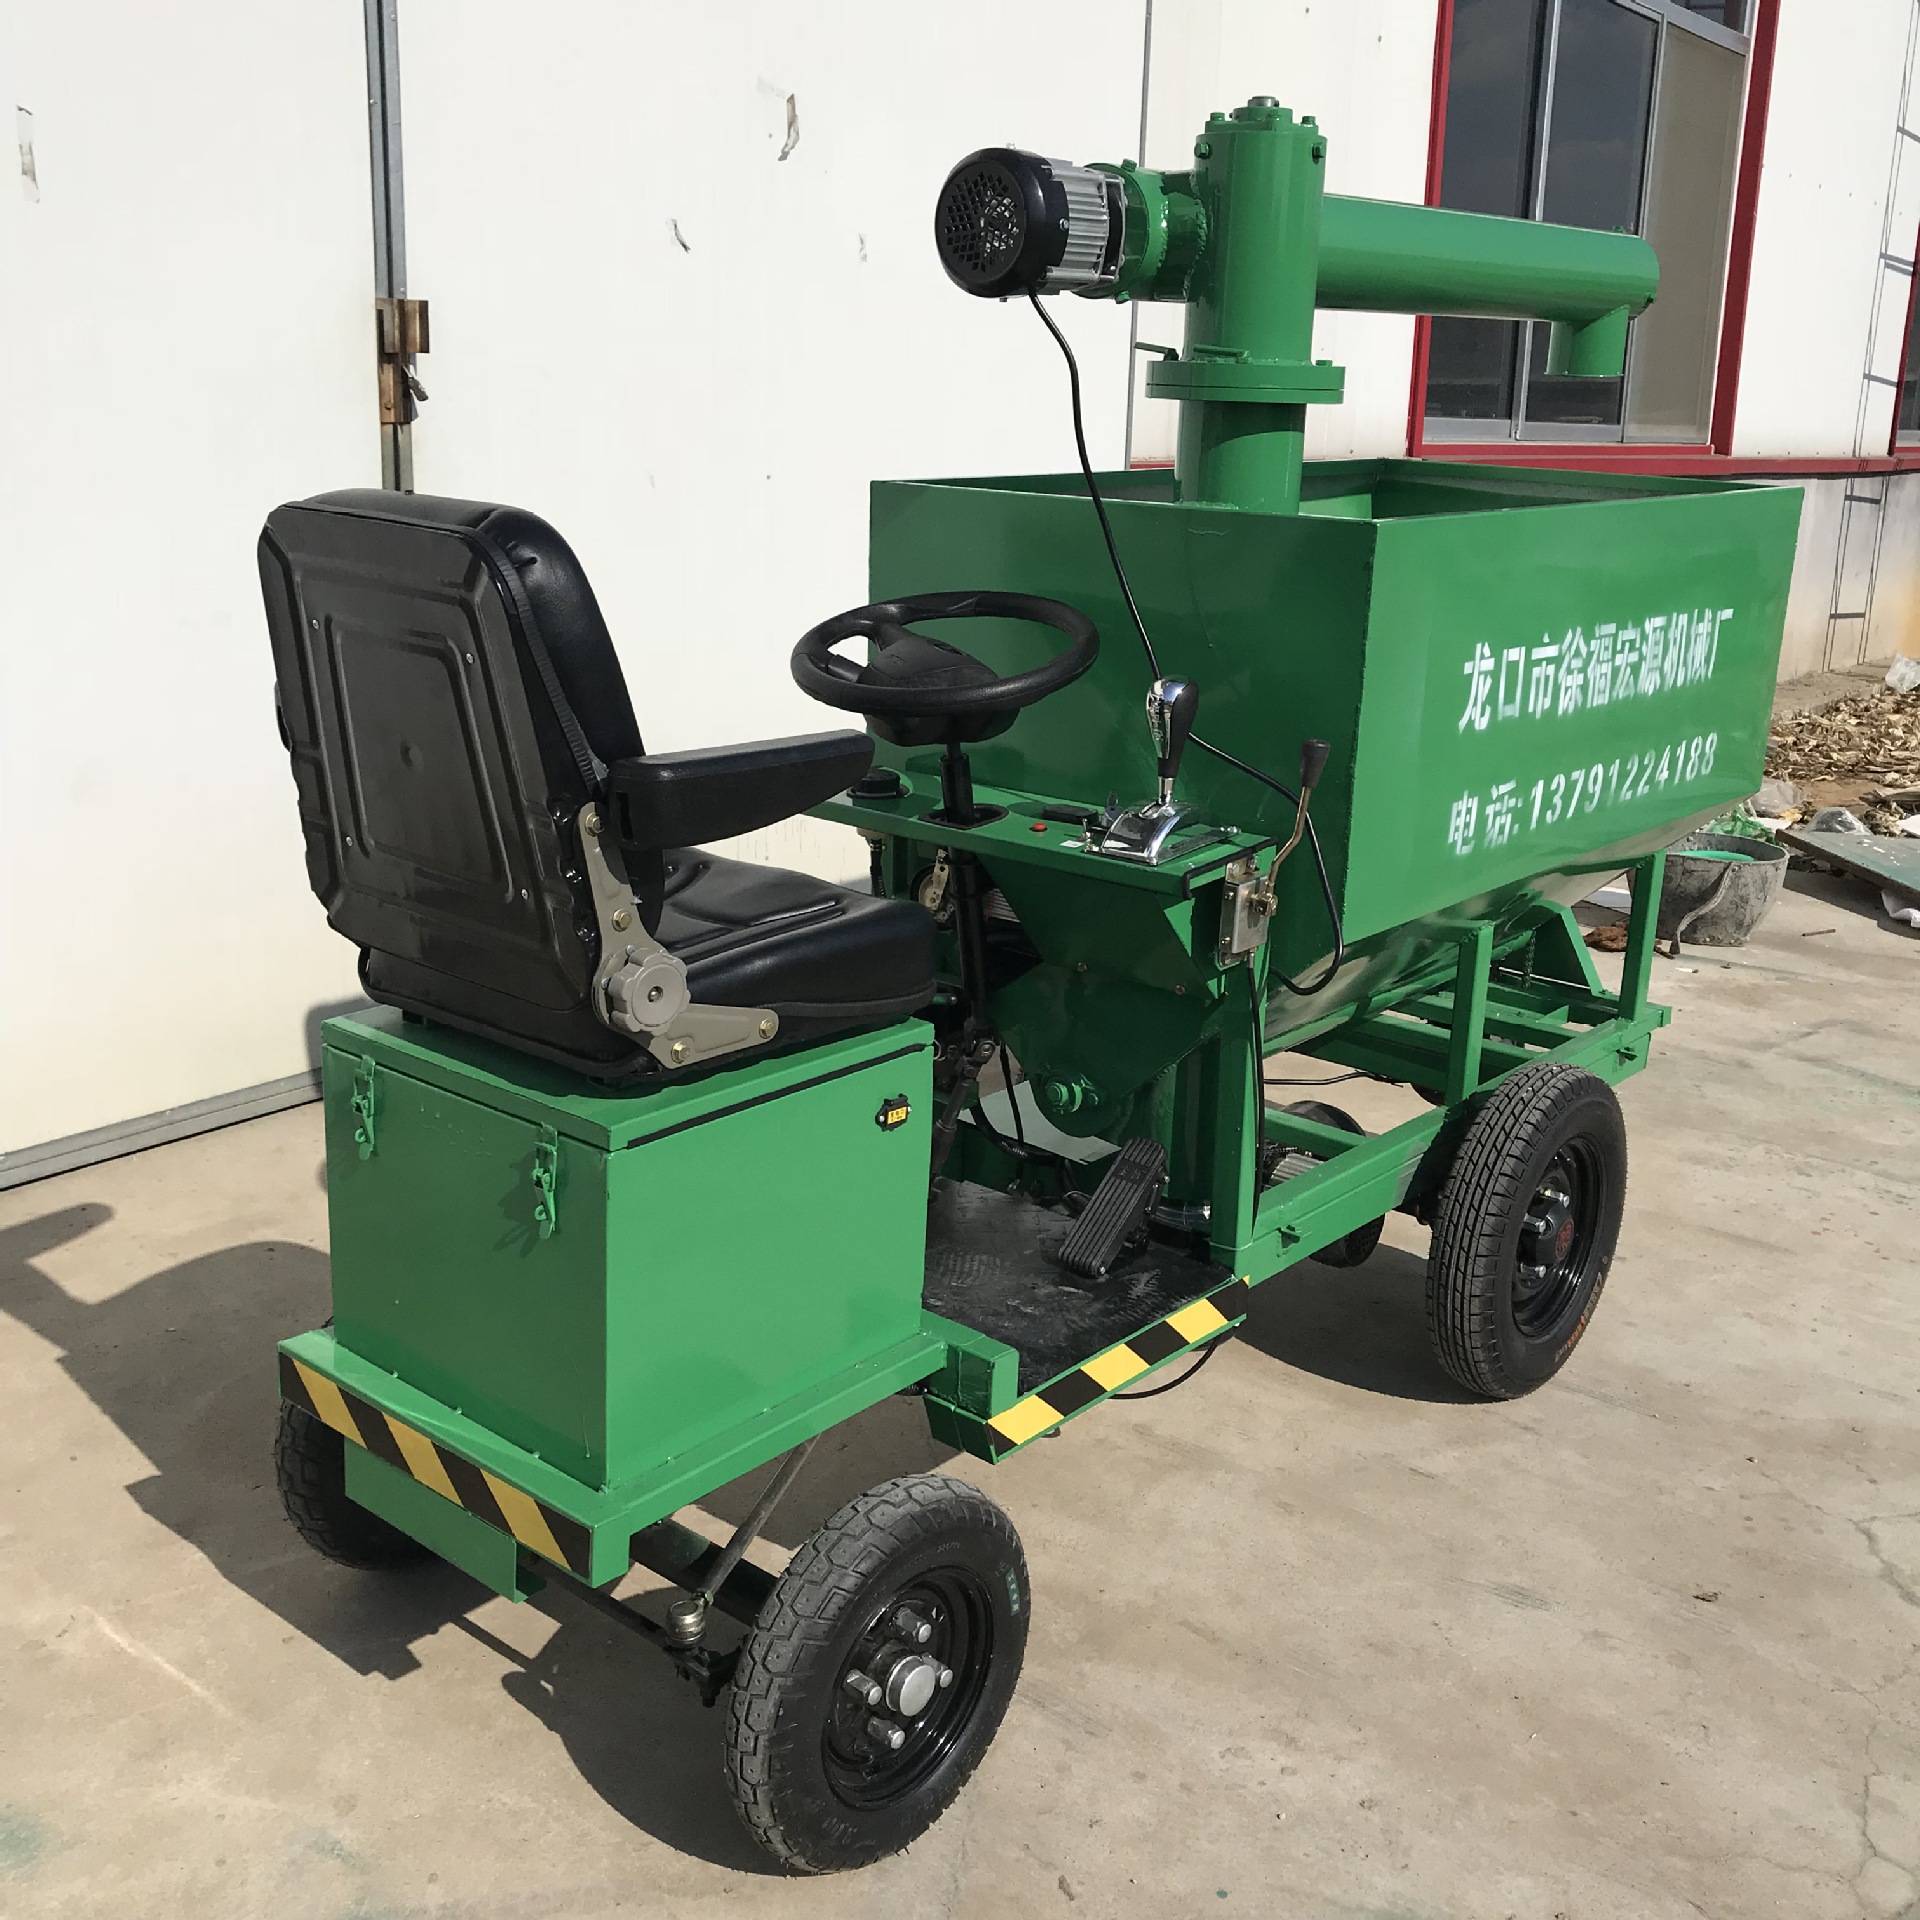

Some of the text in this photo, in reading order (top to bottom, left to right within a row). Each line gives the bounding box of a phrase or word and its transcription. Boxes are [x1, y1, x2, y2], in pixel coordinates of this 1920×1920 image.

[1458, 608, 1734, 734] 龙口市徐福宏源机械厂
